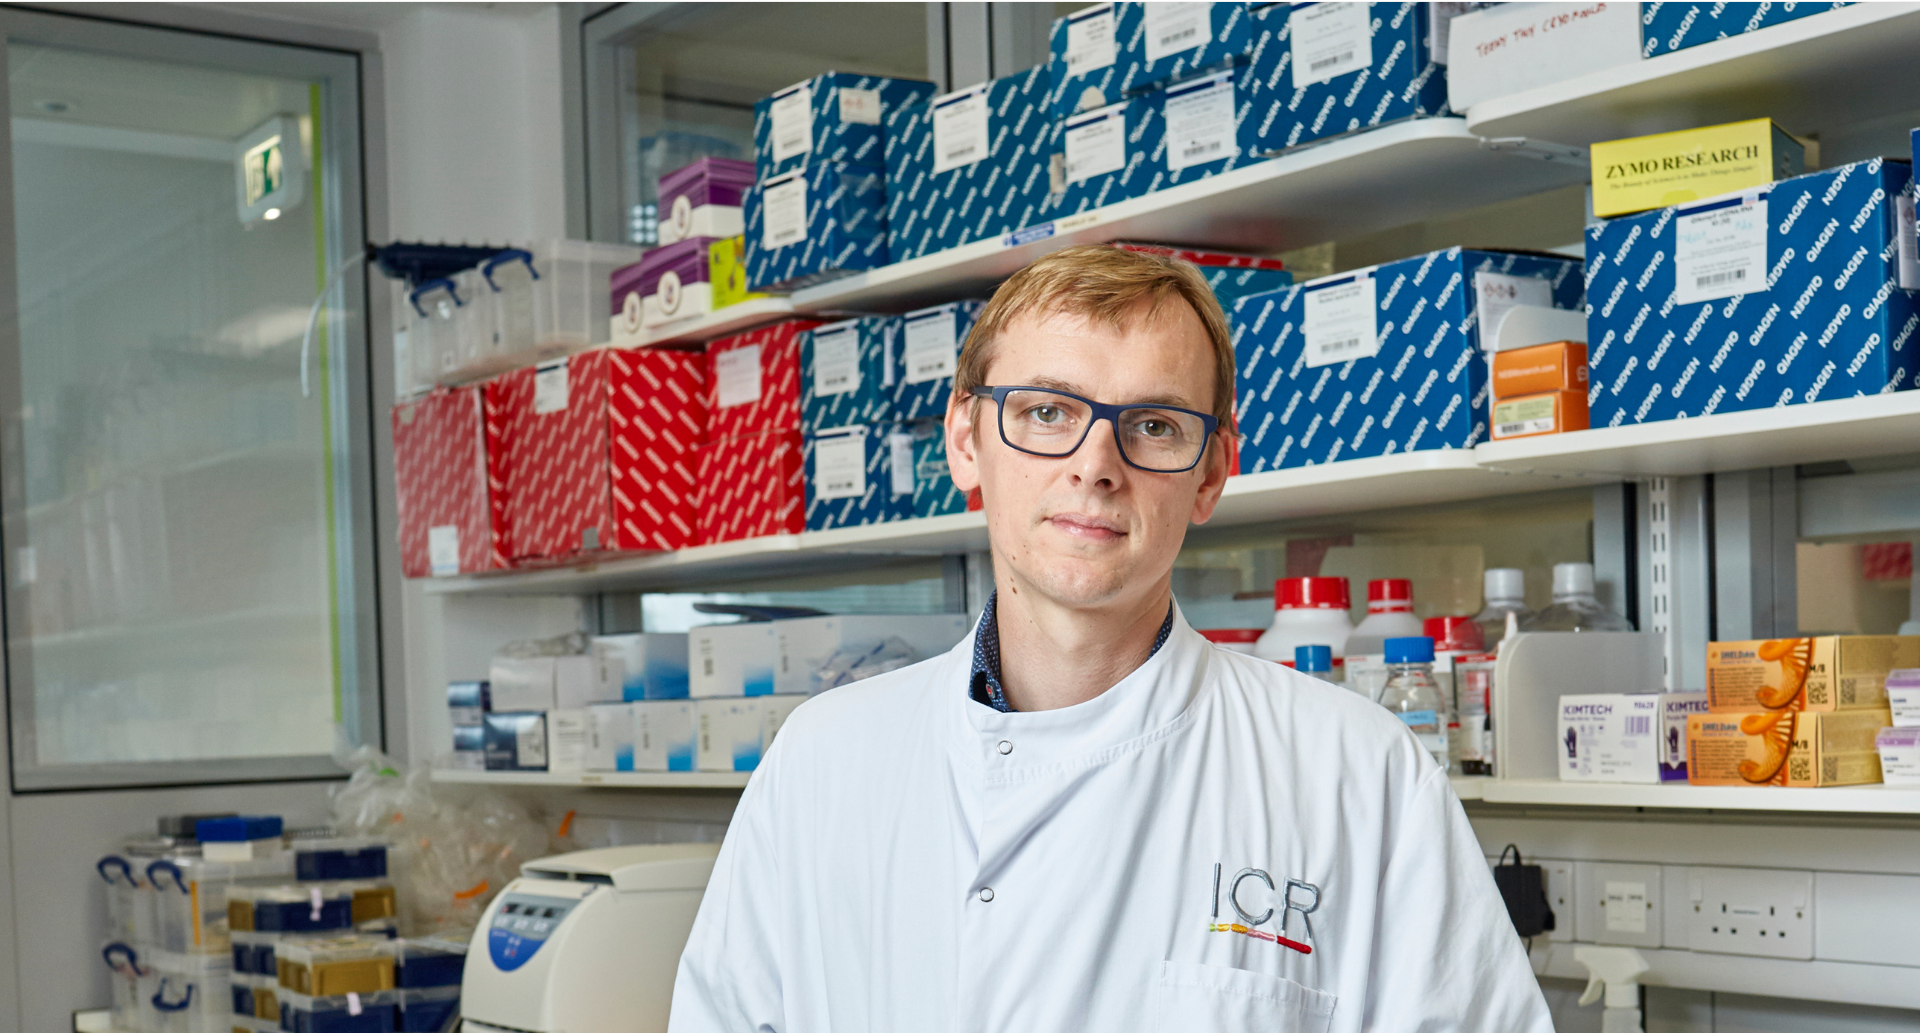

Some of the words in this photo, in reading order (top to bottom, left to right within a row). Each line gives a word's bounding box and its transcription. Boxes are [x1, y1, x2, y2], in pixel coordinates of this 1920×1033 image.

[1668, 5, 1700, 51] QIAGEN
[1377, 39, 1406, 80] QIAGEN
[1344, 68, 1371, 107] QIAGEN
[1258, 100, 1282, 138] QIAGEN
[1311, 95, 1337, 134] QIAGEN
[1605, 158, 1659, 179] ZYMO
[1662, 145, 1759, 170] RESEARCH
[1779, 190, 1812, 234] QIAGEN
[1850, 188, 1886, 233] QIAGEN
[1613, 224, 1642, 266] QIAGEN
[1806, 218, 1840, 262] QIAGEN
[1585, 251, 1606, 290] IAGEN
[1635, 250, 1665, 292] QIAGEN
[1834, 246, 1869, 290] QIAGEN
[1380, 273, 1406, 311] QIAGEN
[1434, 272, 1462, 311] QIAGEN
[1601, 277, 1628, 318] QIAGEN
[1790, 275, 1823, 320] QIAGEN
[1862, 278, 1898, 319] QIAGEN
[1402, 296, 1428, 335] QIAGEN
[1624, 303, 1652, 344] QIAGEN
[1684, 303, 1714, 346] QIAGEN
[1749, 303, 1781, 346] QIAGEN
[1818, 303, 1851, 348] QIAGEN
[1893, 312, 1920, 351] QIAGEN
[1424, 320, 1451, 359] QIAGEN
[1589, 329, 1616, 370] QIAGEN
[1647, 329, 1676, 371] QIAGEN
[1709, 330, 1739, 374] QIAGEN
[1776, 331, 1808, 375] QIAGEN
[1846, 333, 1881, 378] QIAGEN
[1391, 344, 1416, 382] QIAGEN
[1447, 345, 1475, 383] QIAGEN
[1611, 356, 1638, 396] QIAGEN
[1671, 357, 1701, 399] QIAGEN
[1735, 359, 1766, 402] QIAGEN
[1804, 360, 1837, 403] QIAGEN
[1360, 367, 1384, 405] QIAGEN
[1413, 368, 1439, 407] QIAGEN
[1634, 382, 1662, 423] QIAGEN
[1382, 392, 1406, 429] QIAGEN
[1436, 393, 1462, 432] QIAGEN
[1562, 703, 1613, 715] KIMTECH
[1666, 701, 1709, 712] KIMTEC
[1211, 862, 1321, 939] ICR
